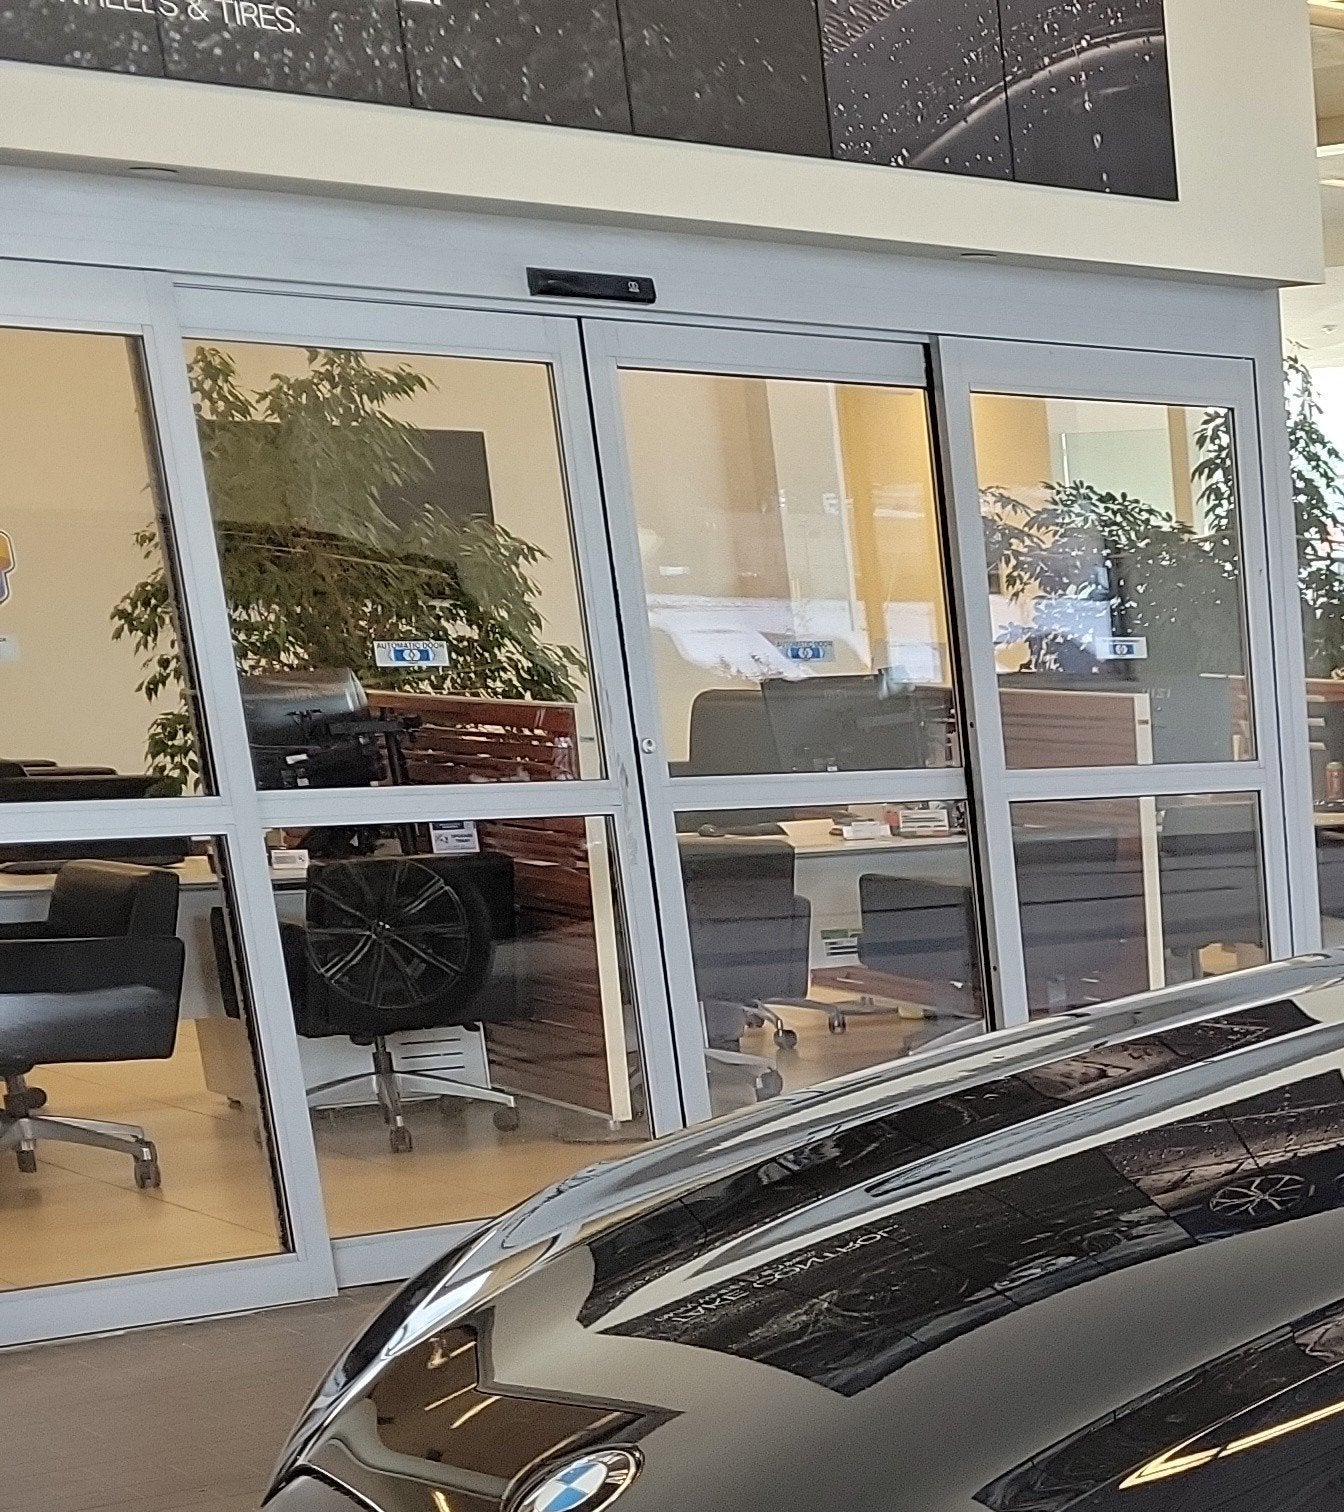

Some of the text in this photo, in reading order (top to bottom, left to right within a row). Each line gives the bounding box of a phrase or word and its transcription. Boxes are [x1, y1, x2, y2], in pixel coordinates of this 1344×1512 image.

[187, 0, 210, 22] &
[220, 0, 302, 34] TIRES.
[422, 642, 445, 650] DOOR
